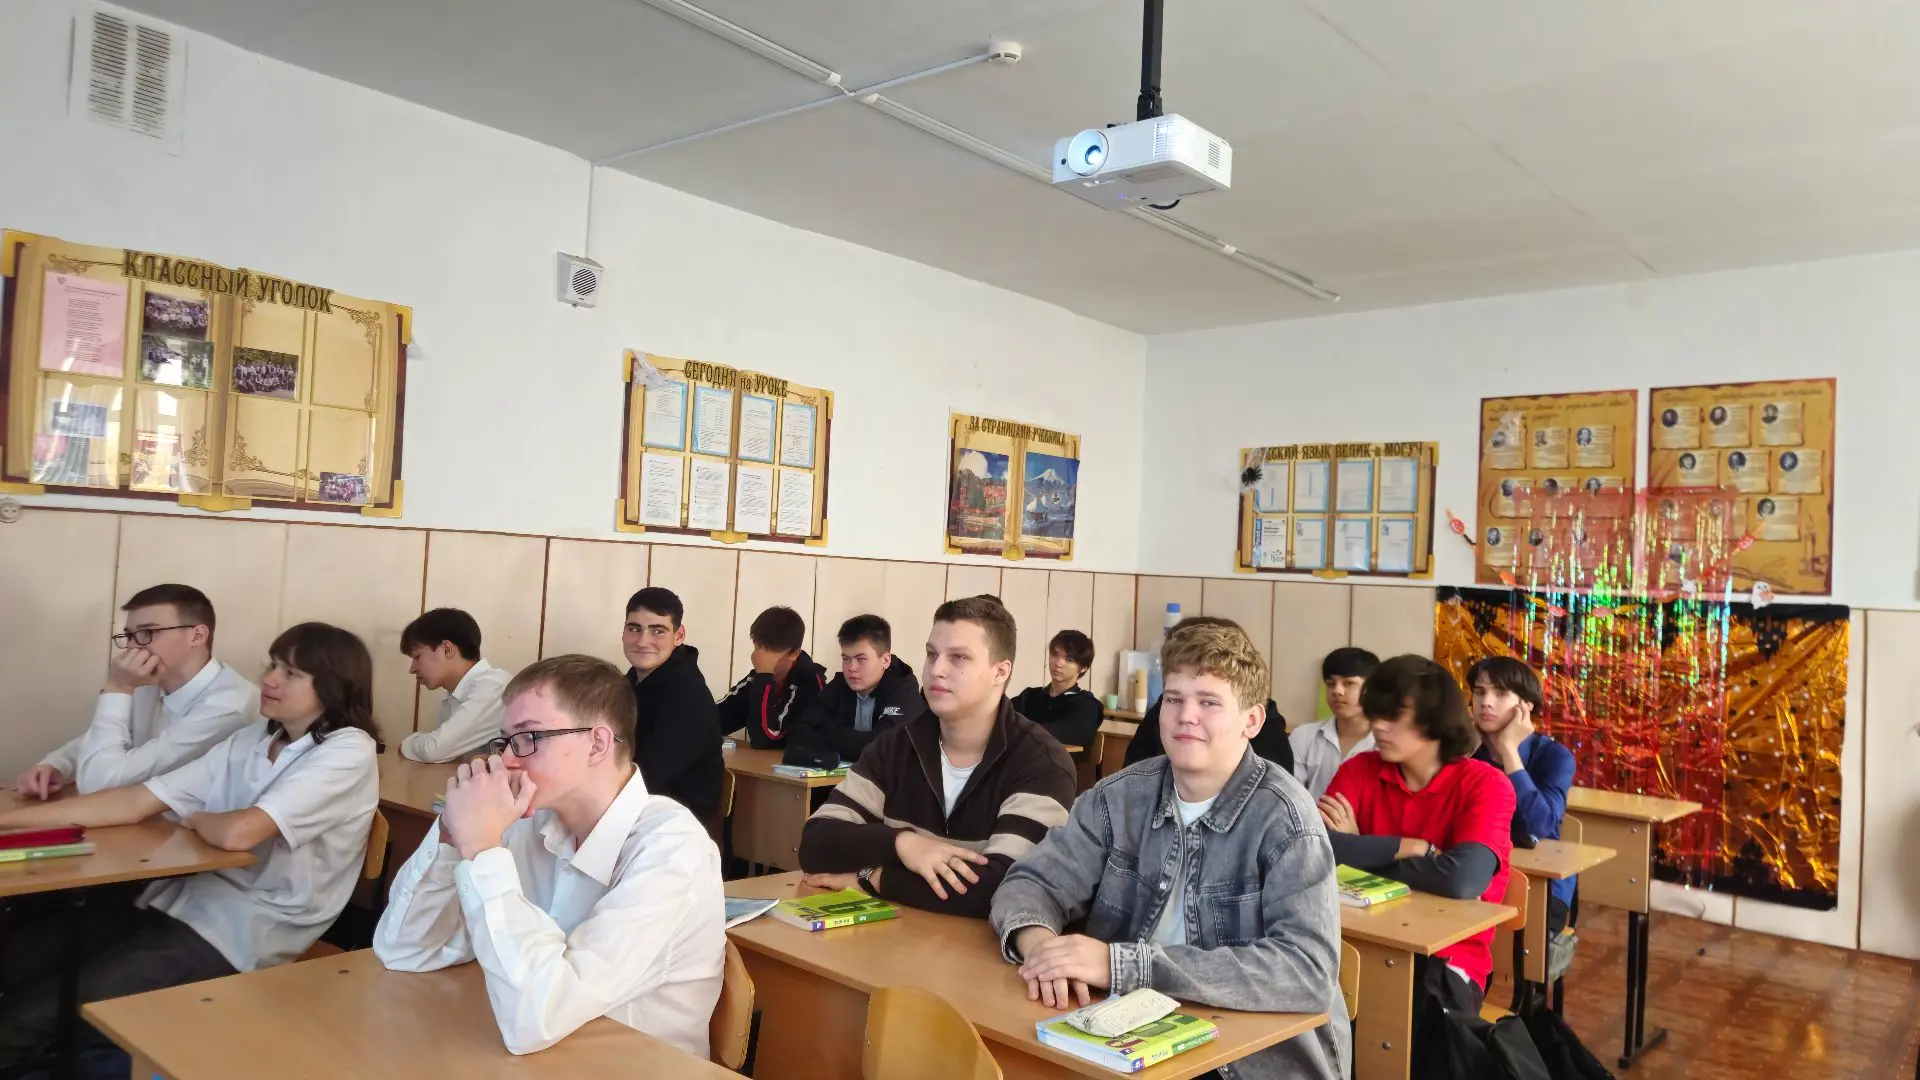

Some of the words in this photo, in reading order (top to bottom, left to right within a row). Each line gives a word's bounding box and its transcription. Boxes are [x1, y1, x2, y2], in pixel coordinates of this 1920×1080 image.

[122, 249, 250, 298] КЛАССНЫЙ
[256, 275, 334, 313] УГОЛОК
[684, 360, 737, 388] СЕГОДНЯ
[740, 376, 751, 391] на
[753, 373, 788, 398] УРОКЕ
[969, 415, 980, 431] ЗА
[1302, 444, 1332, 460] ЯЗЫК
[1336, 443, 1372, 459] ВЕЛИК
